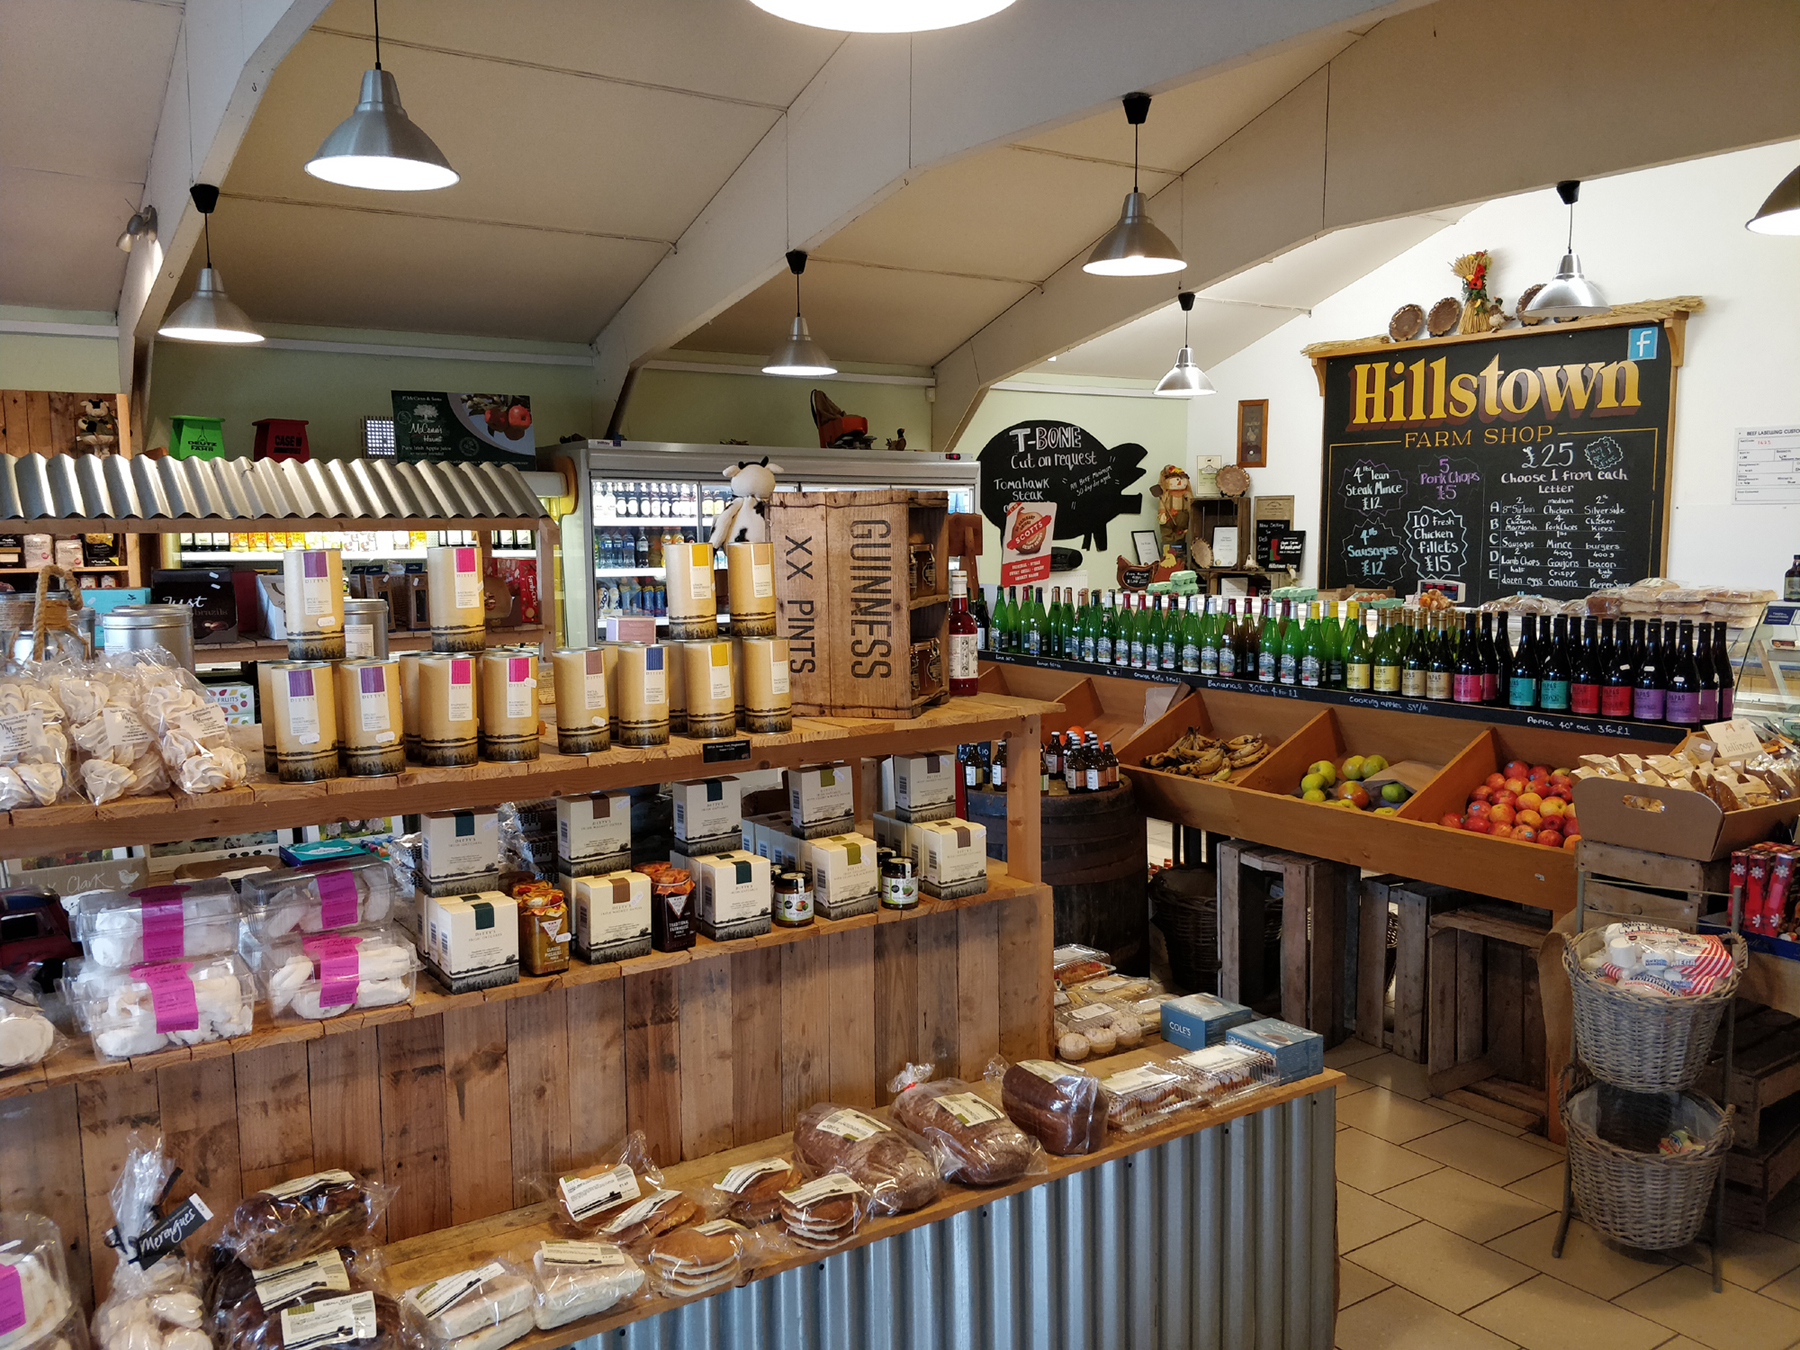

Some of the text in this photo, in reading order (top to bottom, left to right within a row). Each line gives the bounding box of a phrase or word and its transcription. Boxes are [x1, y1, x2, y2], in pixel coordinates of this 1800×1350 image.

[1353, 353, 1641, 424] Hillstown
[409, 423, 443, 434] McCann's
[275, 435, 295, 447] CASE
[1009, 426, 1081, 452] T-BONE
[1404, 425, 1555, 449] FARM SHOP
[1011, 451, 1097, 471] Cut on request
[1521, 442, 1574, 469] £25
[1439, 458, 1450, 474] 5
[1371, 470, 1390, 480] lean
[1421, 471, 1480, 485] Pork Chops
[1501, 468, 1629, 484] Choose 1 from each
[1346, 482, 1403, 496] Steak Mince
[1538, 484, 1575, 494] Letter
[1362, 497, 1383, 510] £12
[1490, 501, 1500, 513] A
[1543, 505, 1574, 515] Chicken
[1412, 515, 1429, 528] 10
[1490, 518, 1499, 530] B
[1015, 521, 1043, 544] SCOTTS
[1414, 528, 1454, 540] Chicken
[1489, 533, 1499, 544] C
[1594, 532, 1604, 541] 4
[1502, 537, 1534, 549] Sausages
[1546, 539, 1572, 549] Mince
[1585, 542, 1620, 551] burgers
[1347, 545, 1399, 560] Sausages
[1490, 551, 1499, 562] D
[1425, 555, 1452, 572] £15
[1501, 555, 1540, 567] Lamb Chops
[1547, 558, 1579, 569] Goujons
[1588, 559, 1616, 568] bacon
[1362, 560, 1385, 576] £12
[1489, 569, 1498, 579] E
[1549, 570, 1576, 578] Crispy
[1501, 574, 1543, 587] dozen eggs
[1548, 578, 1578, 588] Onions
[162, 596, 208, 609] Just
[785, 535, 816, 674] XX PINTS
[850, 519, 892, 679] GUINNESS
[1207, 680, 1242, 690] Bananas
[1349, 696, 1379, 708] Cooking
[1527, 716, 1554, 727] Apples
[1598, 725, 1605, 733] 3
[1723, 741, 1755, 753] lollipops
[1169, 1021, 1191, 1037] COLE'S
[140, 1208, 197, 1253] Meringues
